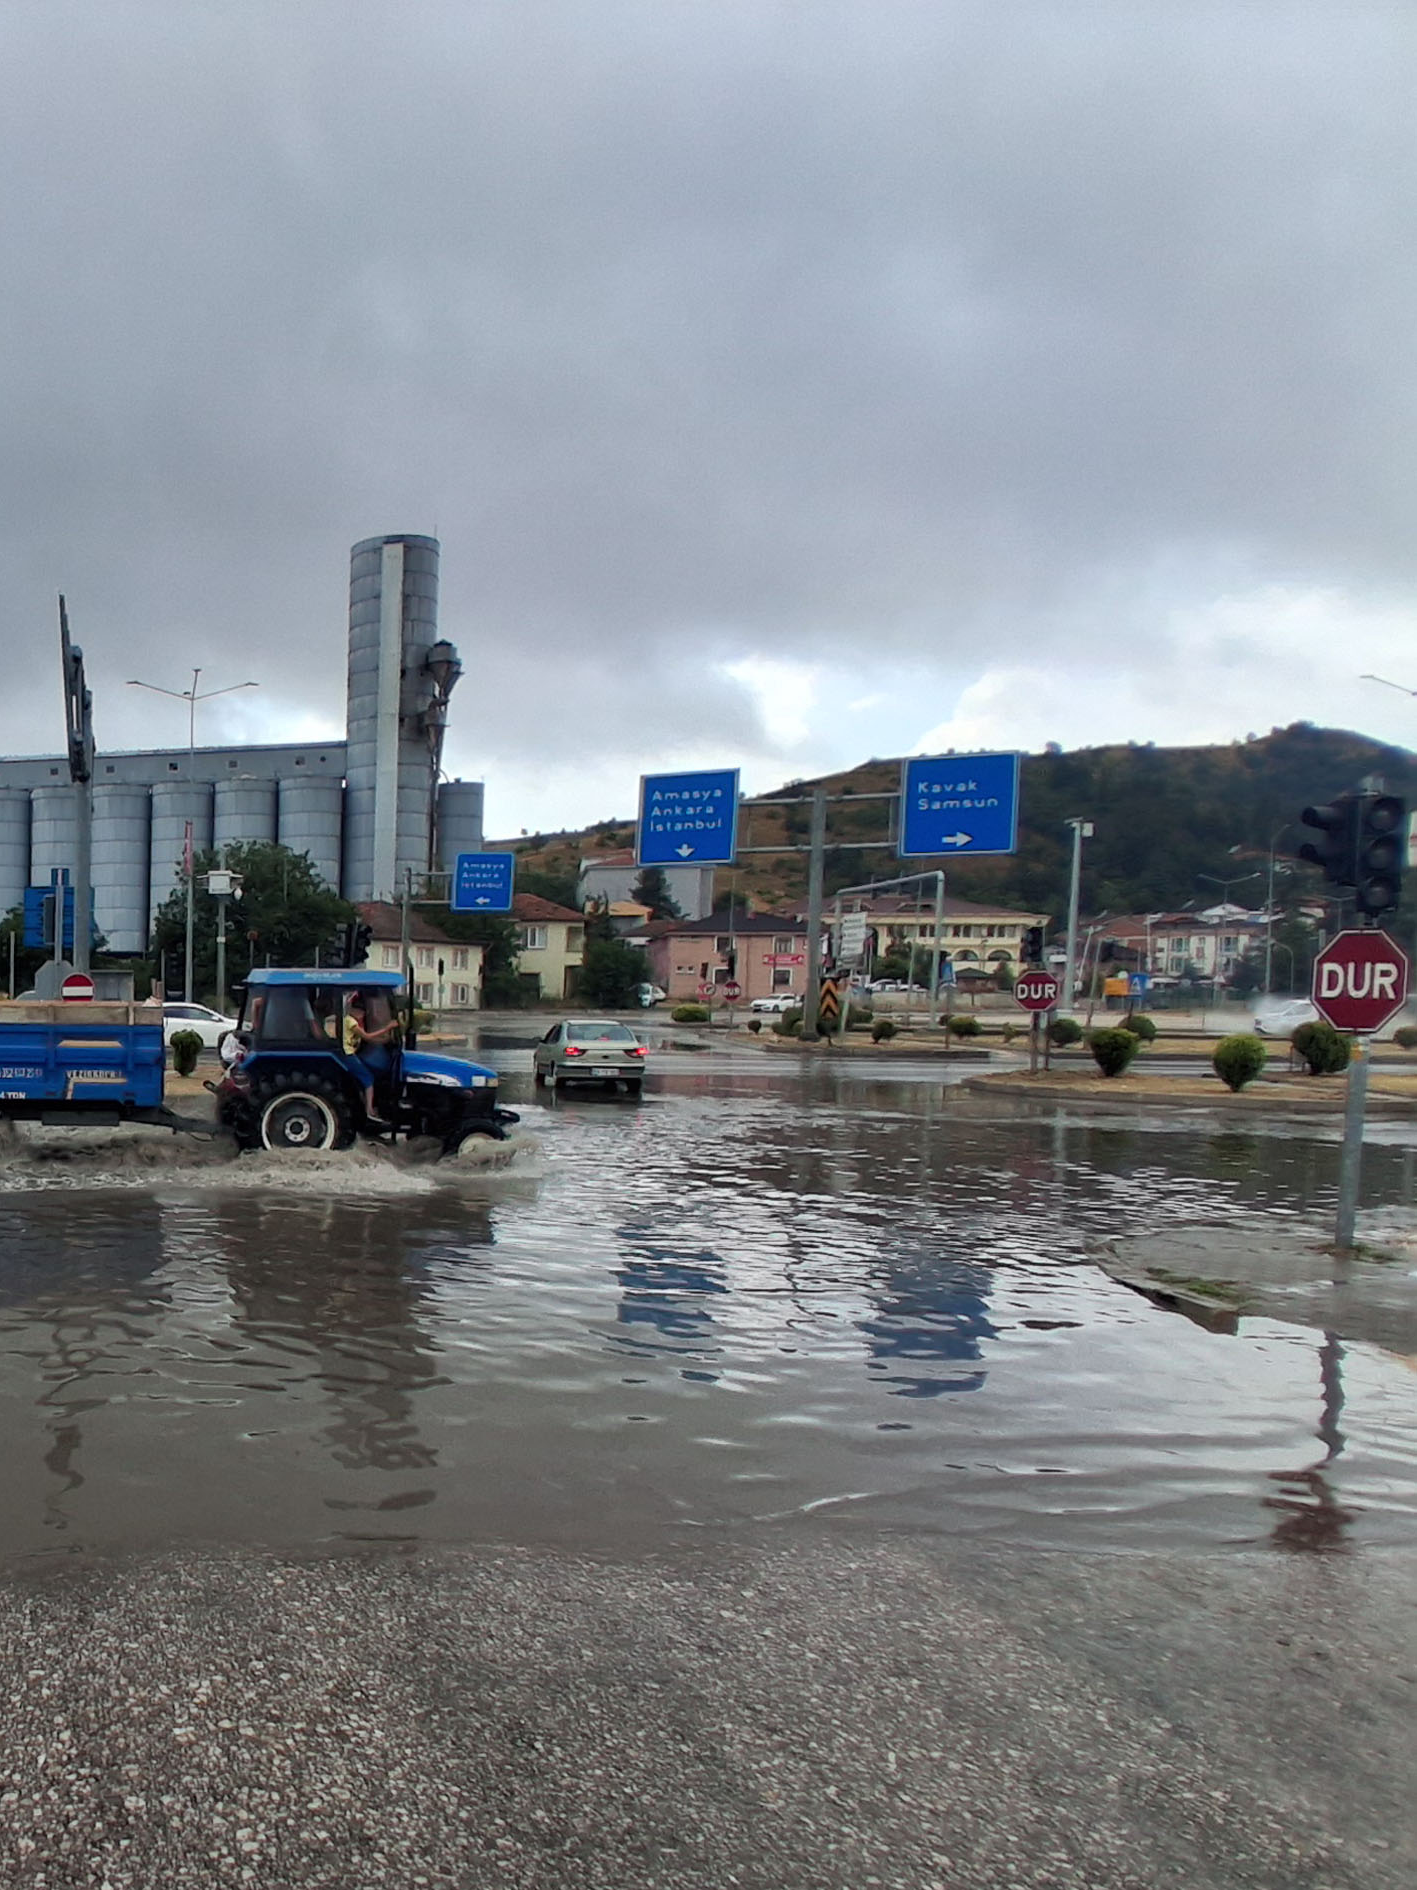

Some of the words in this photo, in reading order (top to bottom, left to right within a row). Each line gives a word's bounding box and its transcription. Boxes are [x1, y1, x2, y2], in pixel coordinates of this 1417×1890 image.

[918, 780, 977, 793] Kavak
[652, 789, 722, 801] Amasya
[918, 798, 998, 810] Samsun
[651, 805, 714, 817] Ankara
[1321, 961, 1398, 999] DUR
[1017, 983, 1056, 1000] DUR
[6, 1091, 26, 1099] TON
